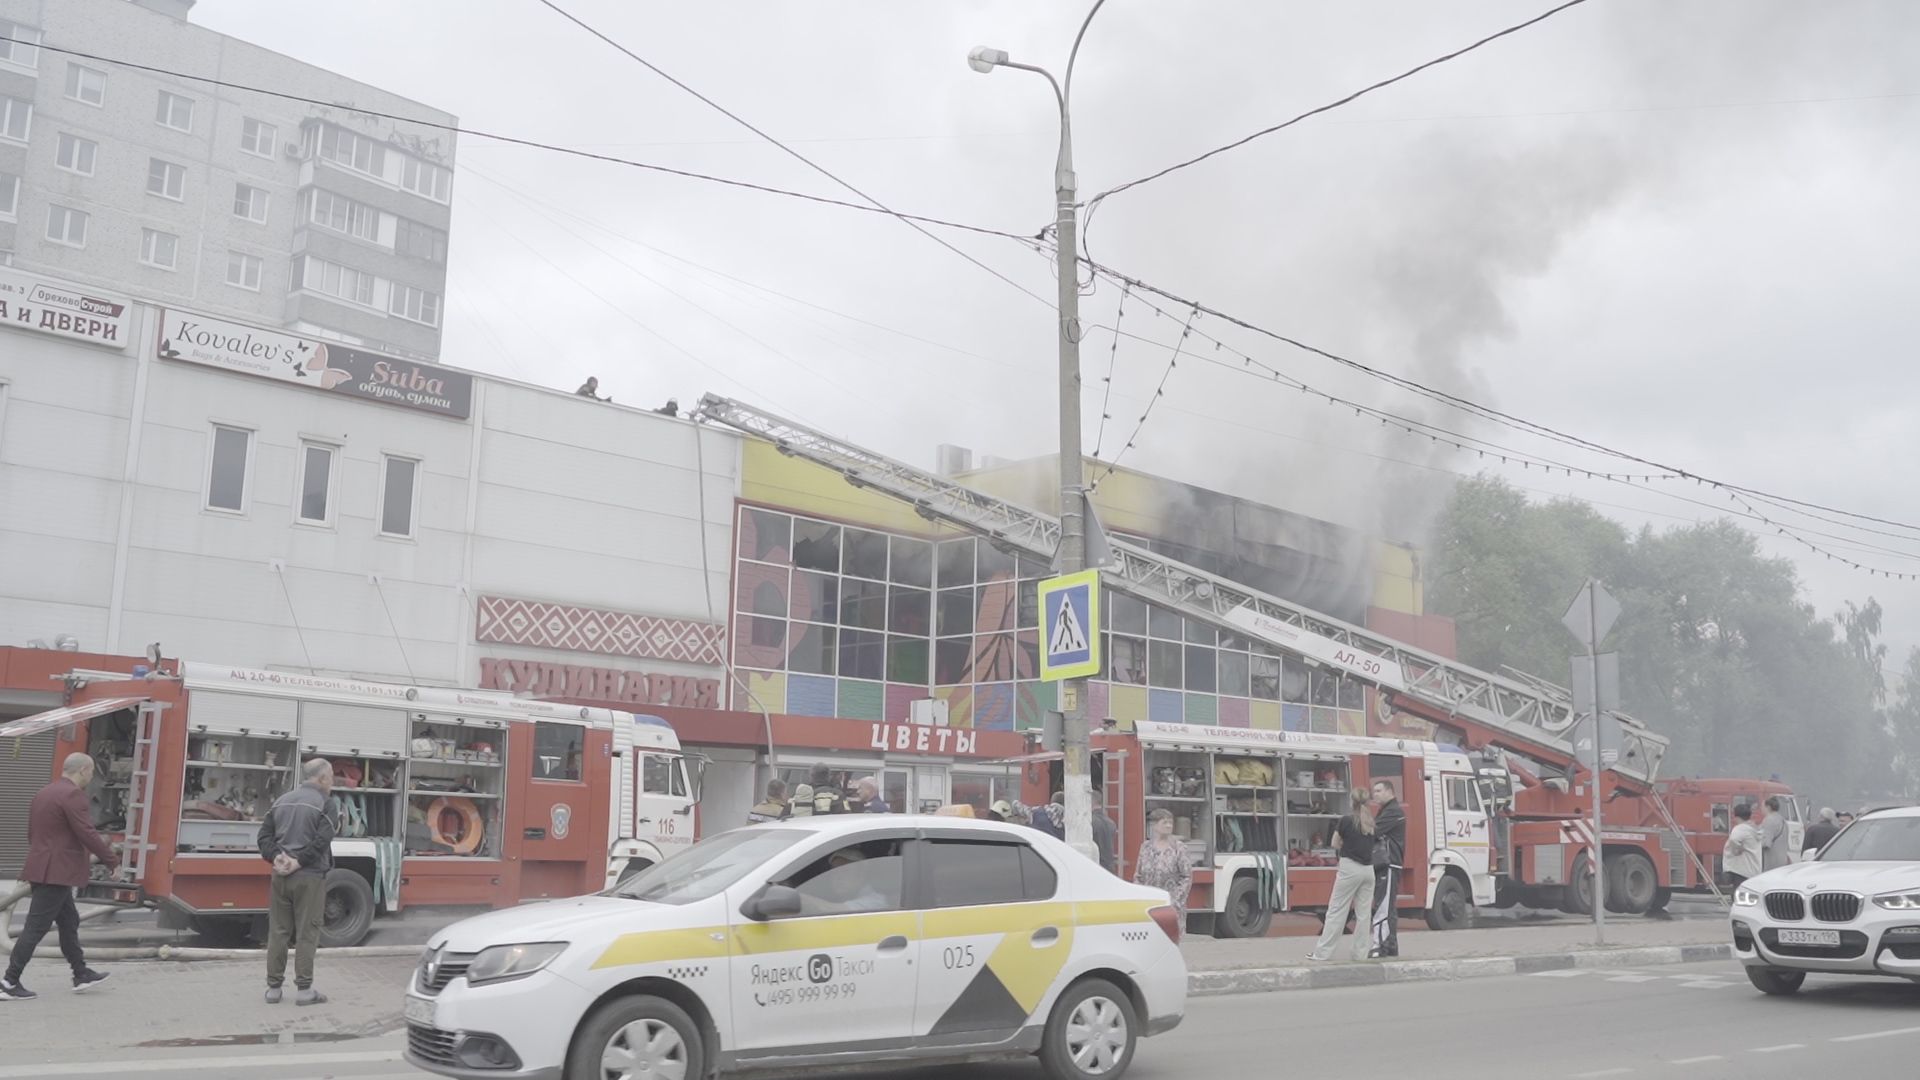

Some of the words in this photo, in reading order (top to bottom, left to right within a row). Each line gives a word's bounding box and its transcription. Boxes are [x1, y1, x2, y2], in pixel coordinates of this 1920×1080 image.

[39, 309, 118, 341] ДВЕРИ
[370, 361, 445, 396] Suba
[283, 677, 341, 689] ТЕЛЕФОН
[478, 657, 721, 709] КУЛИНАРИЯ
[871, 723, 977, 754] ЦВЕТЫ
[658, 818, 675, 835] 116
[1457, 819, 1472, 838] 24
[751, 963, 804, 986] Яндекс
[810, 955, 831, 981] Go
[835, 956, 875, 978] Такси
[943, 944, 975, 970] 025
[767, 988, 795, 1007] (495)
[799, 985, 821, 1003] 999
[824, 982, 840, 1000] 99
[840, 981, 857, 999] 99
